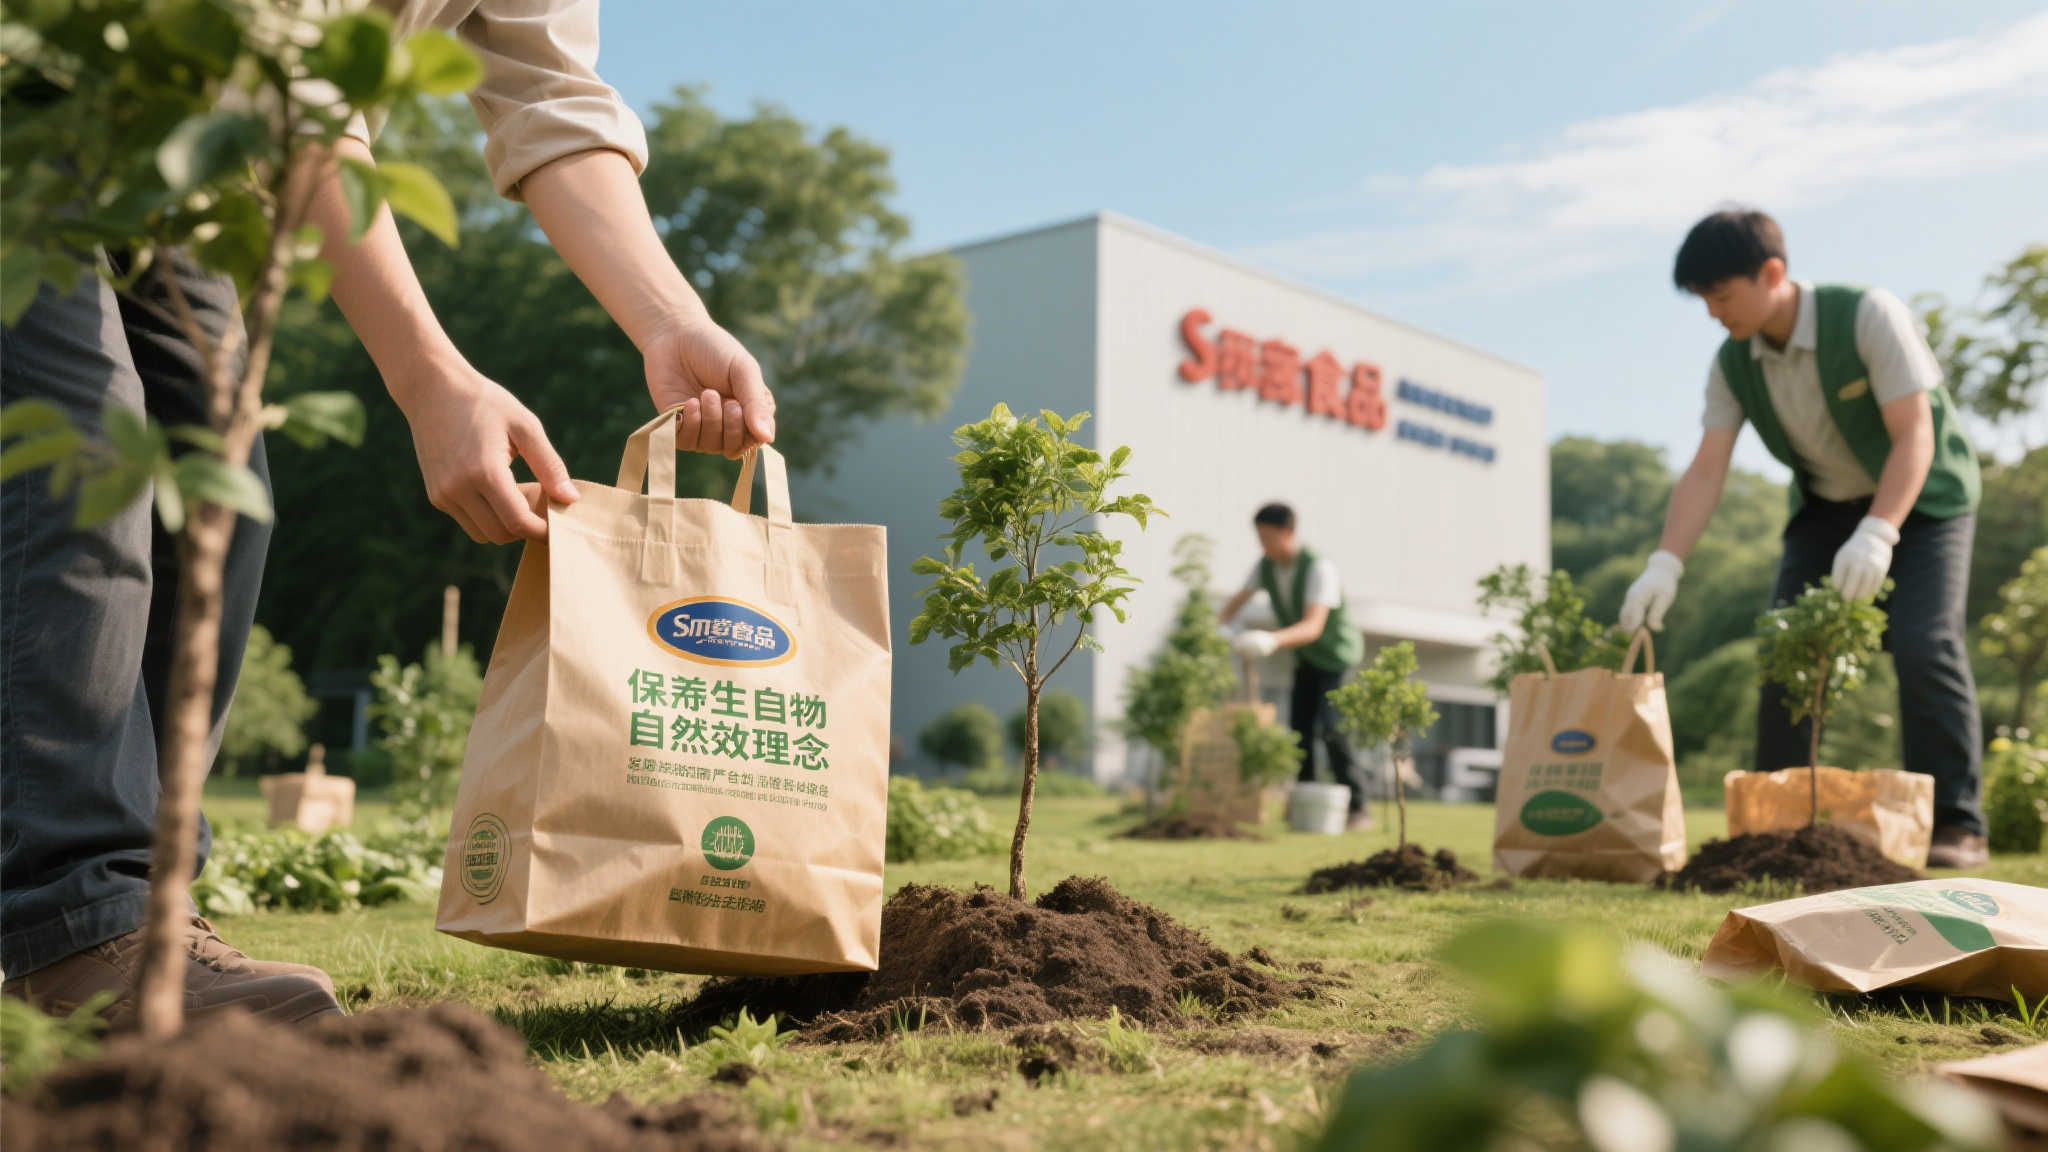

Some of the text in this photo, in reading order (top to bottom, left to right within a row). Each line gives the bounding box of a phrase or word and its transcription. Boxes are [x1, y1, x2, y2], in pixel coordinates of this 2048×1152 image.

[629, 709, 830, 771] 自然效理念
